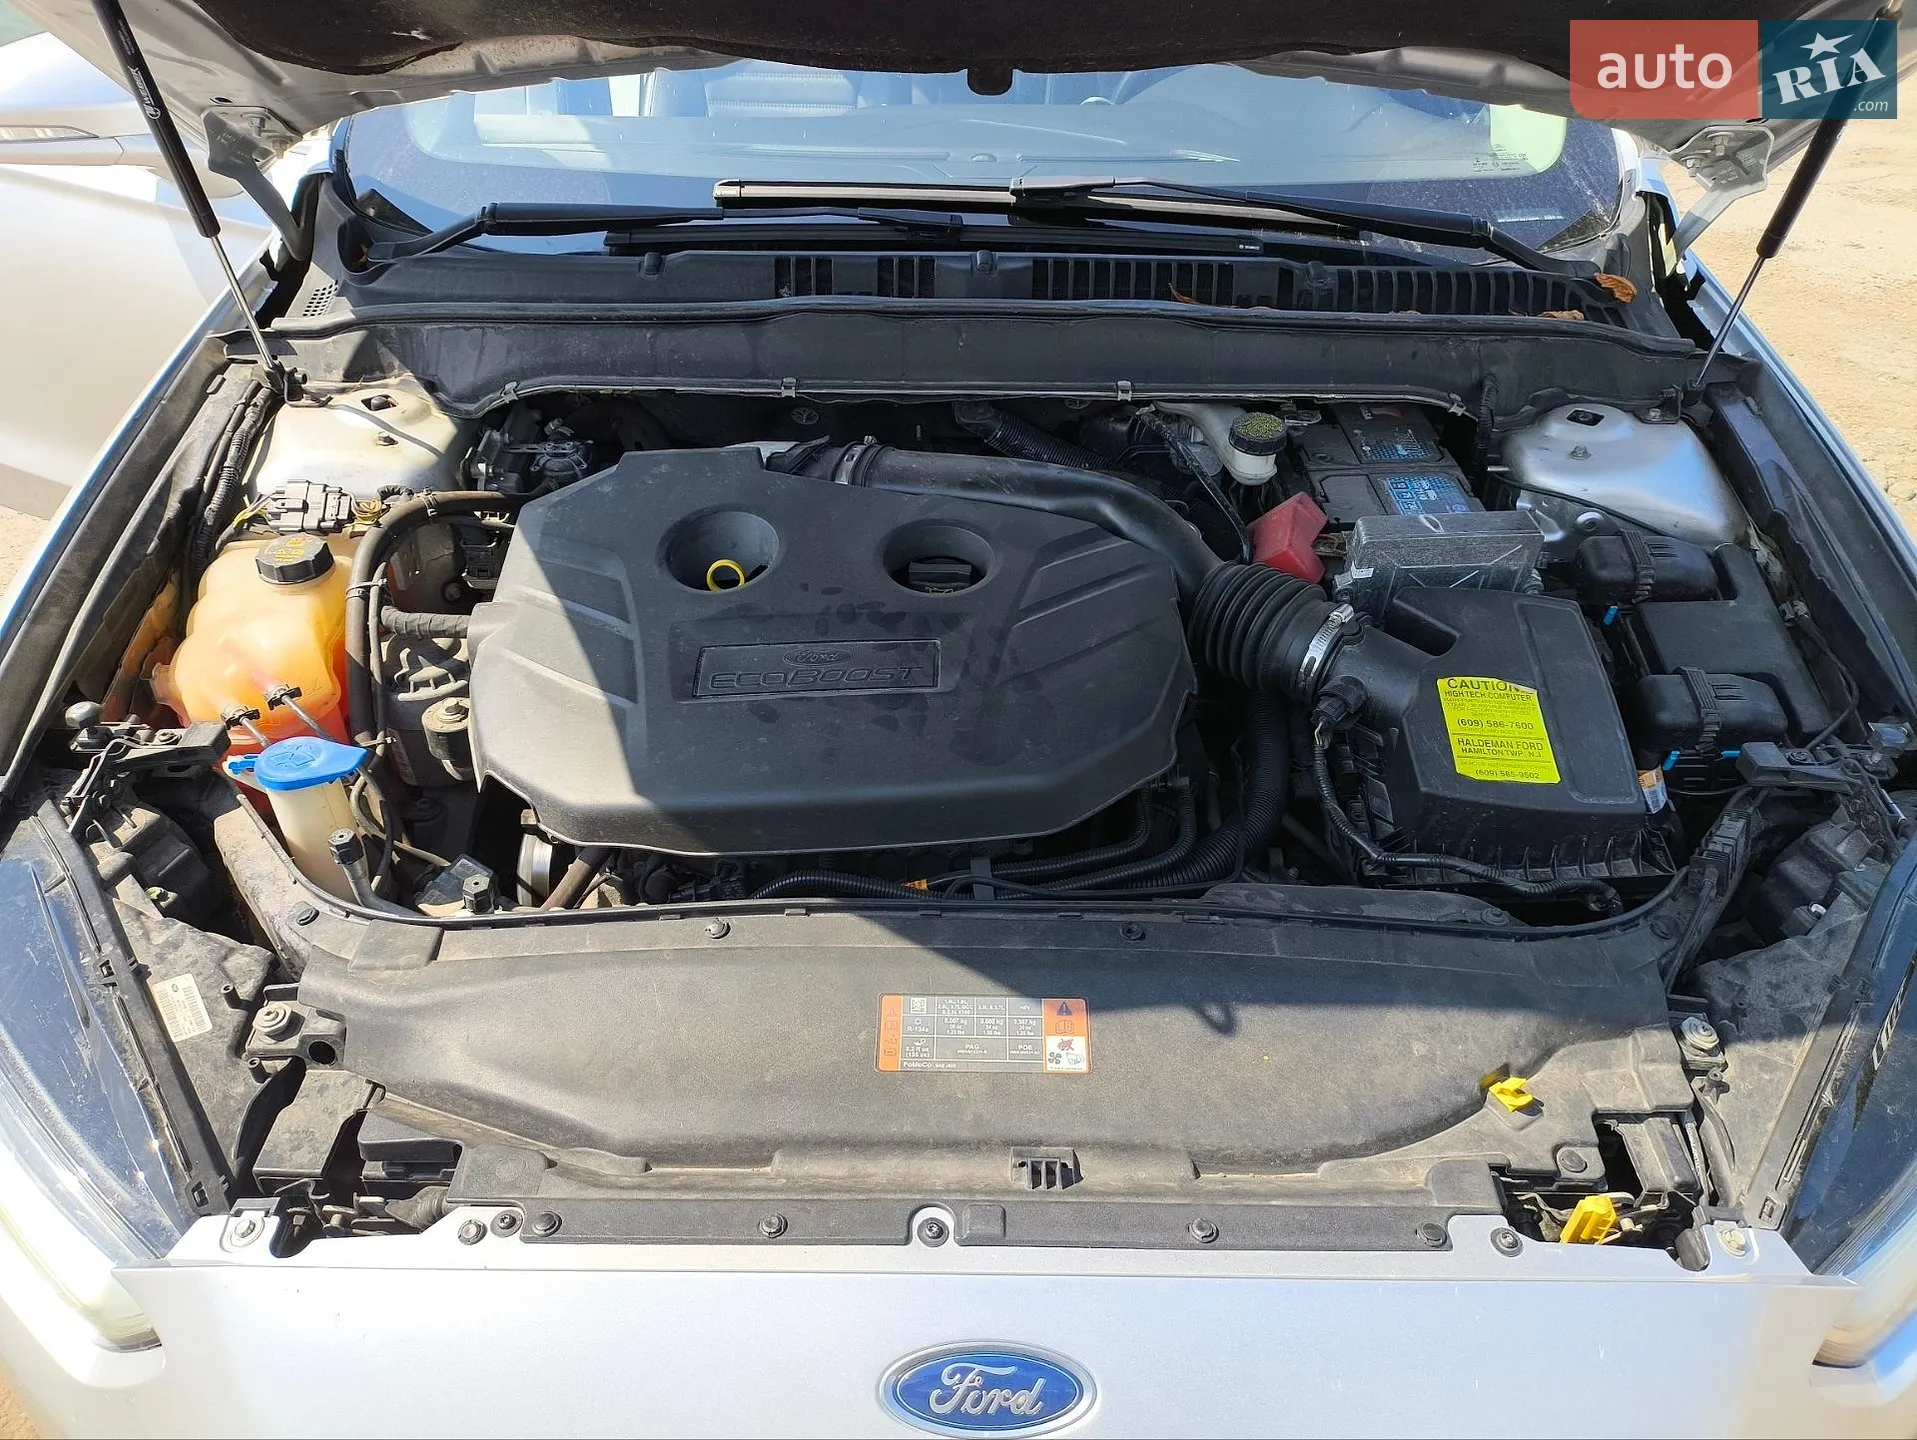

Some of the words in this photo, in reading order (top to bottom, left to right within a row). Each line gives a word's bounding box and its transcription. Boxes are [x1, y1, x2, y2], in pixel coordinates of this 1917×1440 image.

[797, 649, 839, 665] Ford
[1488, 692, 1532, 702] COMPUTER
[1457, 718, 1484, 729] (609)
[1486, 720, 1534, 730] 586-7600
[1457, 738, 1514, 750] HALDEMAN
[1516, 741, 1544, 751] FORD
[1461, 747, 1503, 756] HAMILTON
[929, 1362, 1047, 1415] Ford
